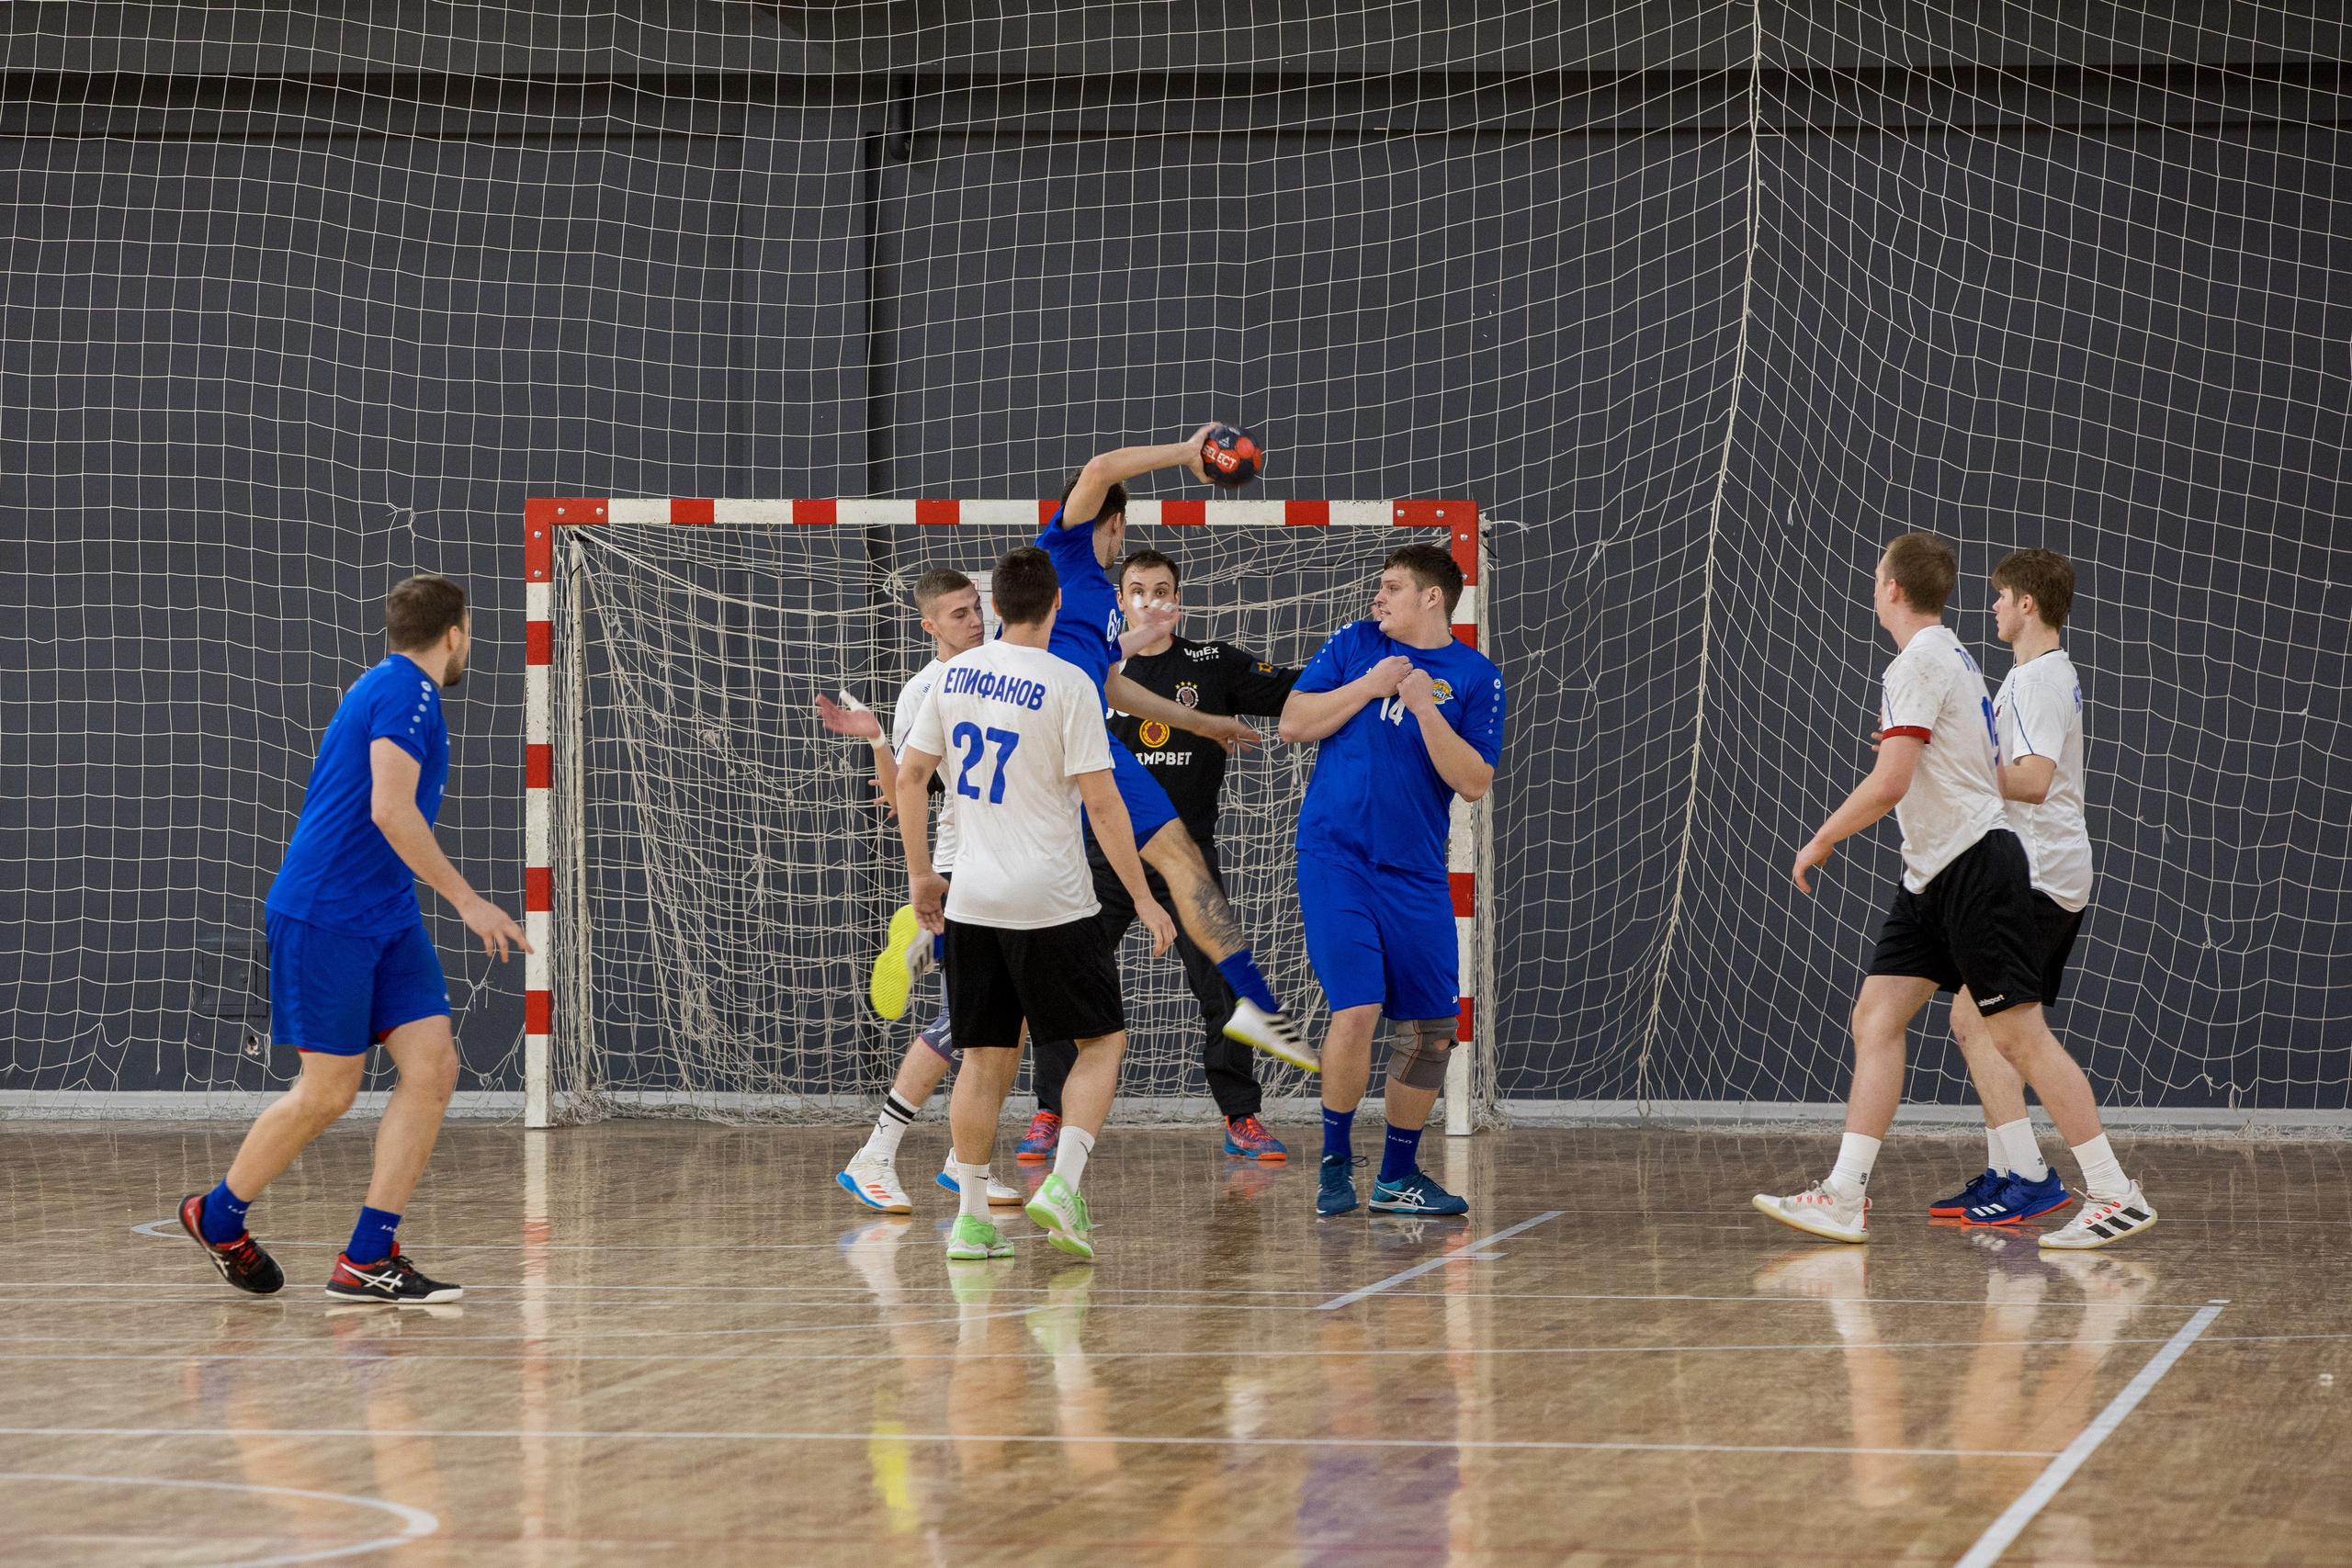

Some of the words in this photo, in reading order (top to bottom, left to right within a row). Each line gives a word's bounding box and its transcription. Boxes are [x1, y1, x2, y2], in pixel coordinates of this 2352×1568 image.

[944, 667, 1046, 711] ЕПИФАНОВ
[1380, 696, 1405, 726] 14
[952, 721, 1020, 805] 27
